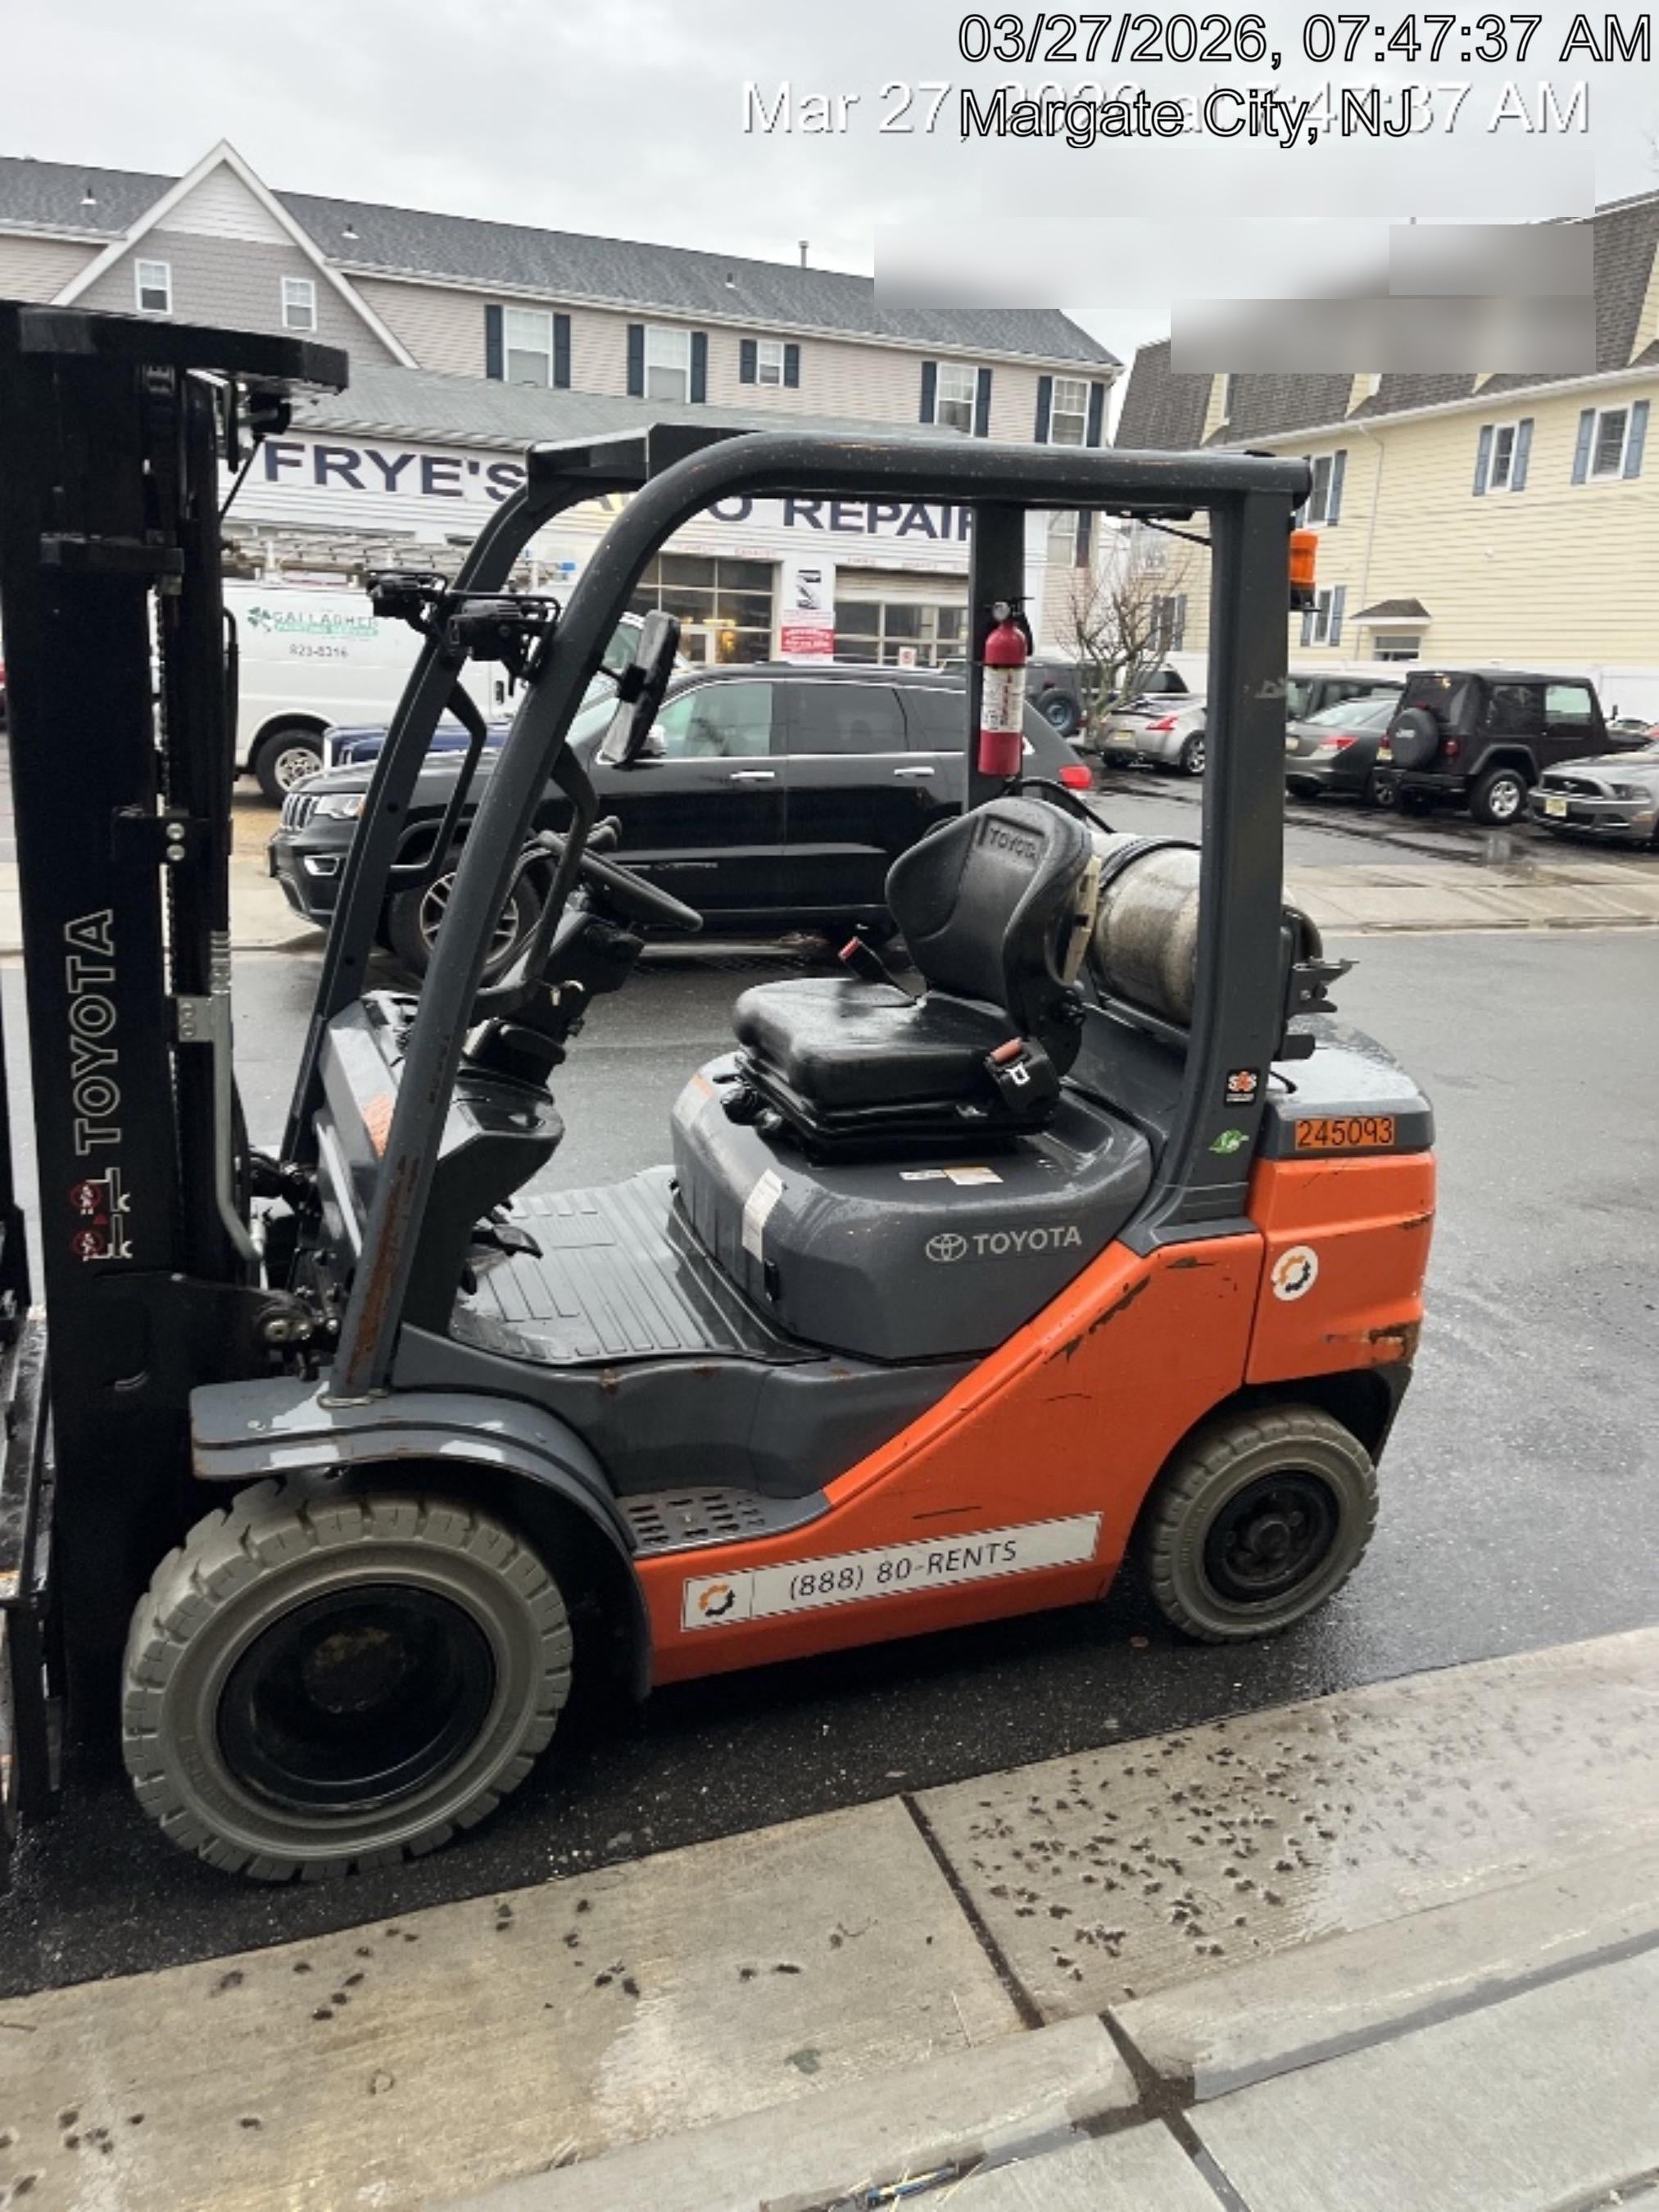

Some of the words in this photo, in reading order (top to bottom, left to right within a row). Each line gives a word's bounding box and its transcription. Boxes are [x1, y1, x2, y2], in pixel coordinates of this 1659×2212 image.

[264, 440, 528, 501] FRYE'S
[989, 827, 1040, 861] TOYOTA
[64, 909, 121, 1156] TOYOTA
[1297, 1117, 1393, 1147] 245093
[972, 1226, 1083, 1255] TOYOTA
[790, 1566, 864, 1601] (888)
[876, 1540, 1018, 1584] 80-RENTS
